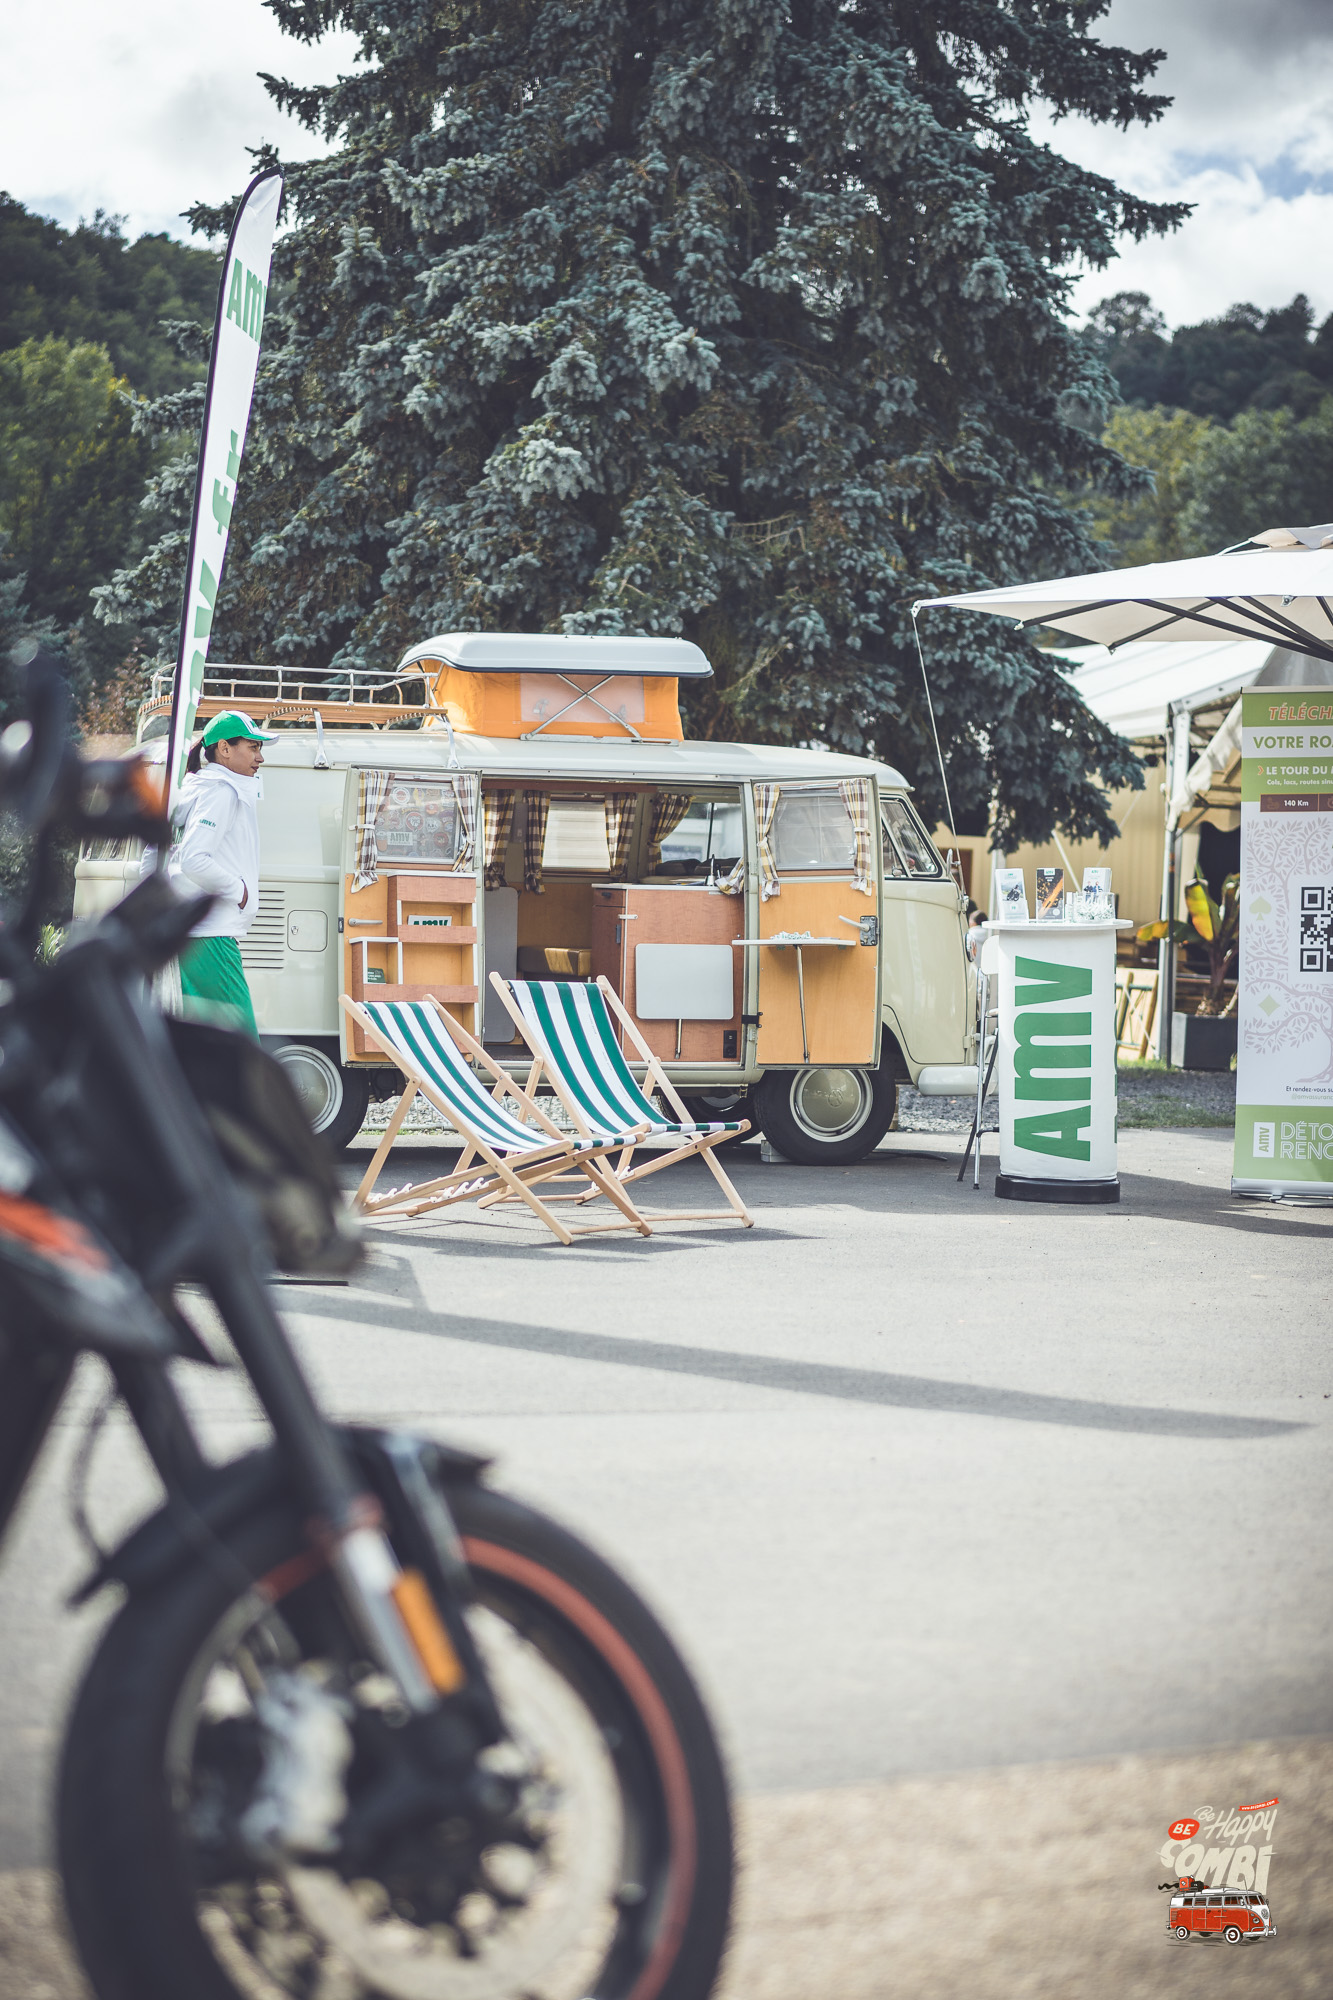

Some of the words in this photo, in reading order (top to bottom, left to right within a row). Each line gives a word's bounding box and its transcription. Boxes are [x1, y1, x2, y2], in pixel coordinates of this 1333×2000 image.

[226, 257, 267, 347] Am
[1269, 702, 1333, 721] TÉLÉCH
[1253, 736, 1304, 749] VOTRE
[1309, 735, 1333, 748] RO
[1266, 766, 1278, 775] LE
[1280, 766, 1310, 775] TOUR
[1312, 766, 1328, 775] DU
[1283, 778, 1299, 786] lacs,
[1297, 799, 1309, 807] Km
[1292, 1085, 1327, 1093] rendez-vous
